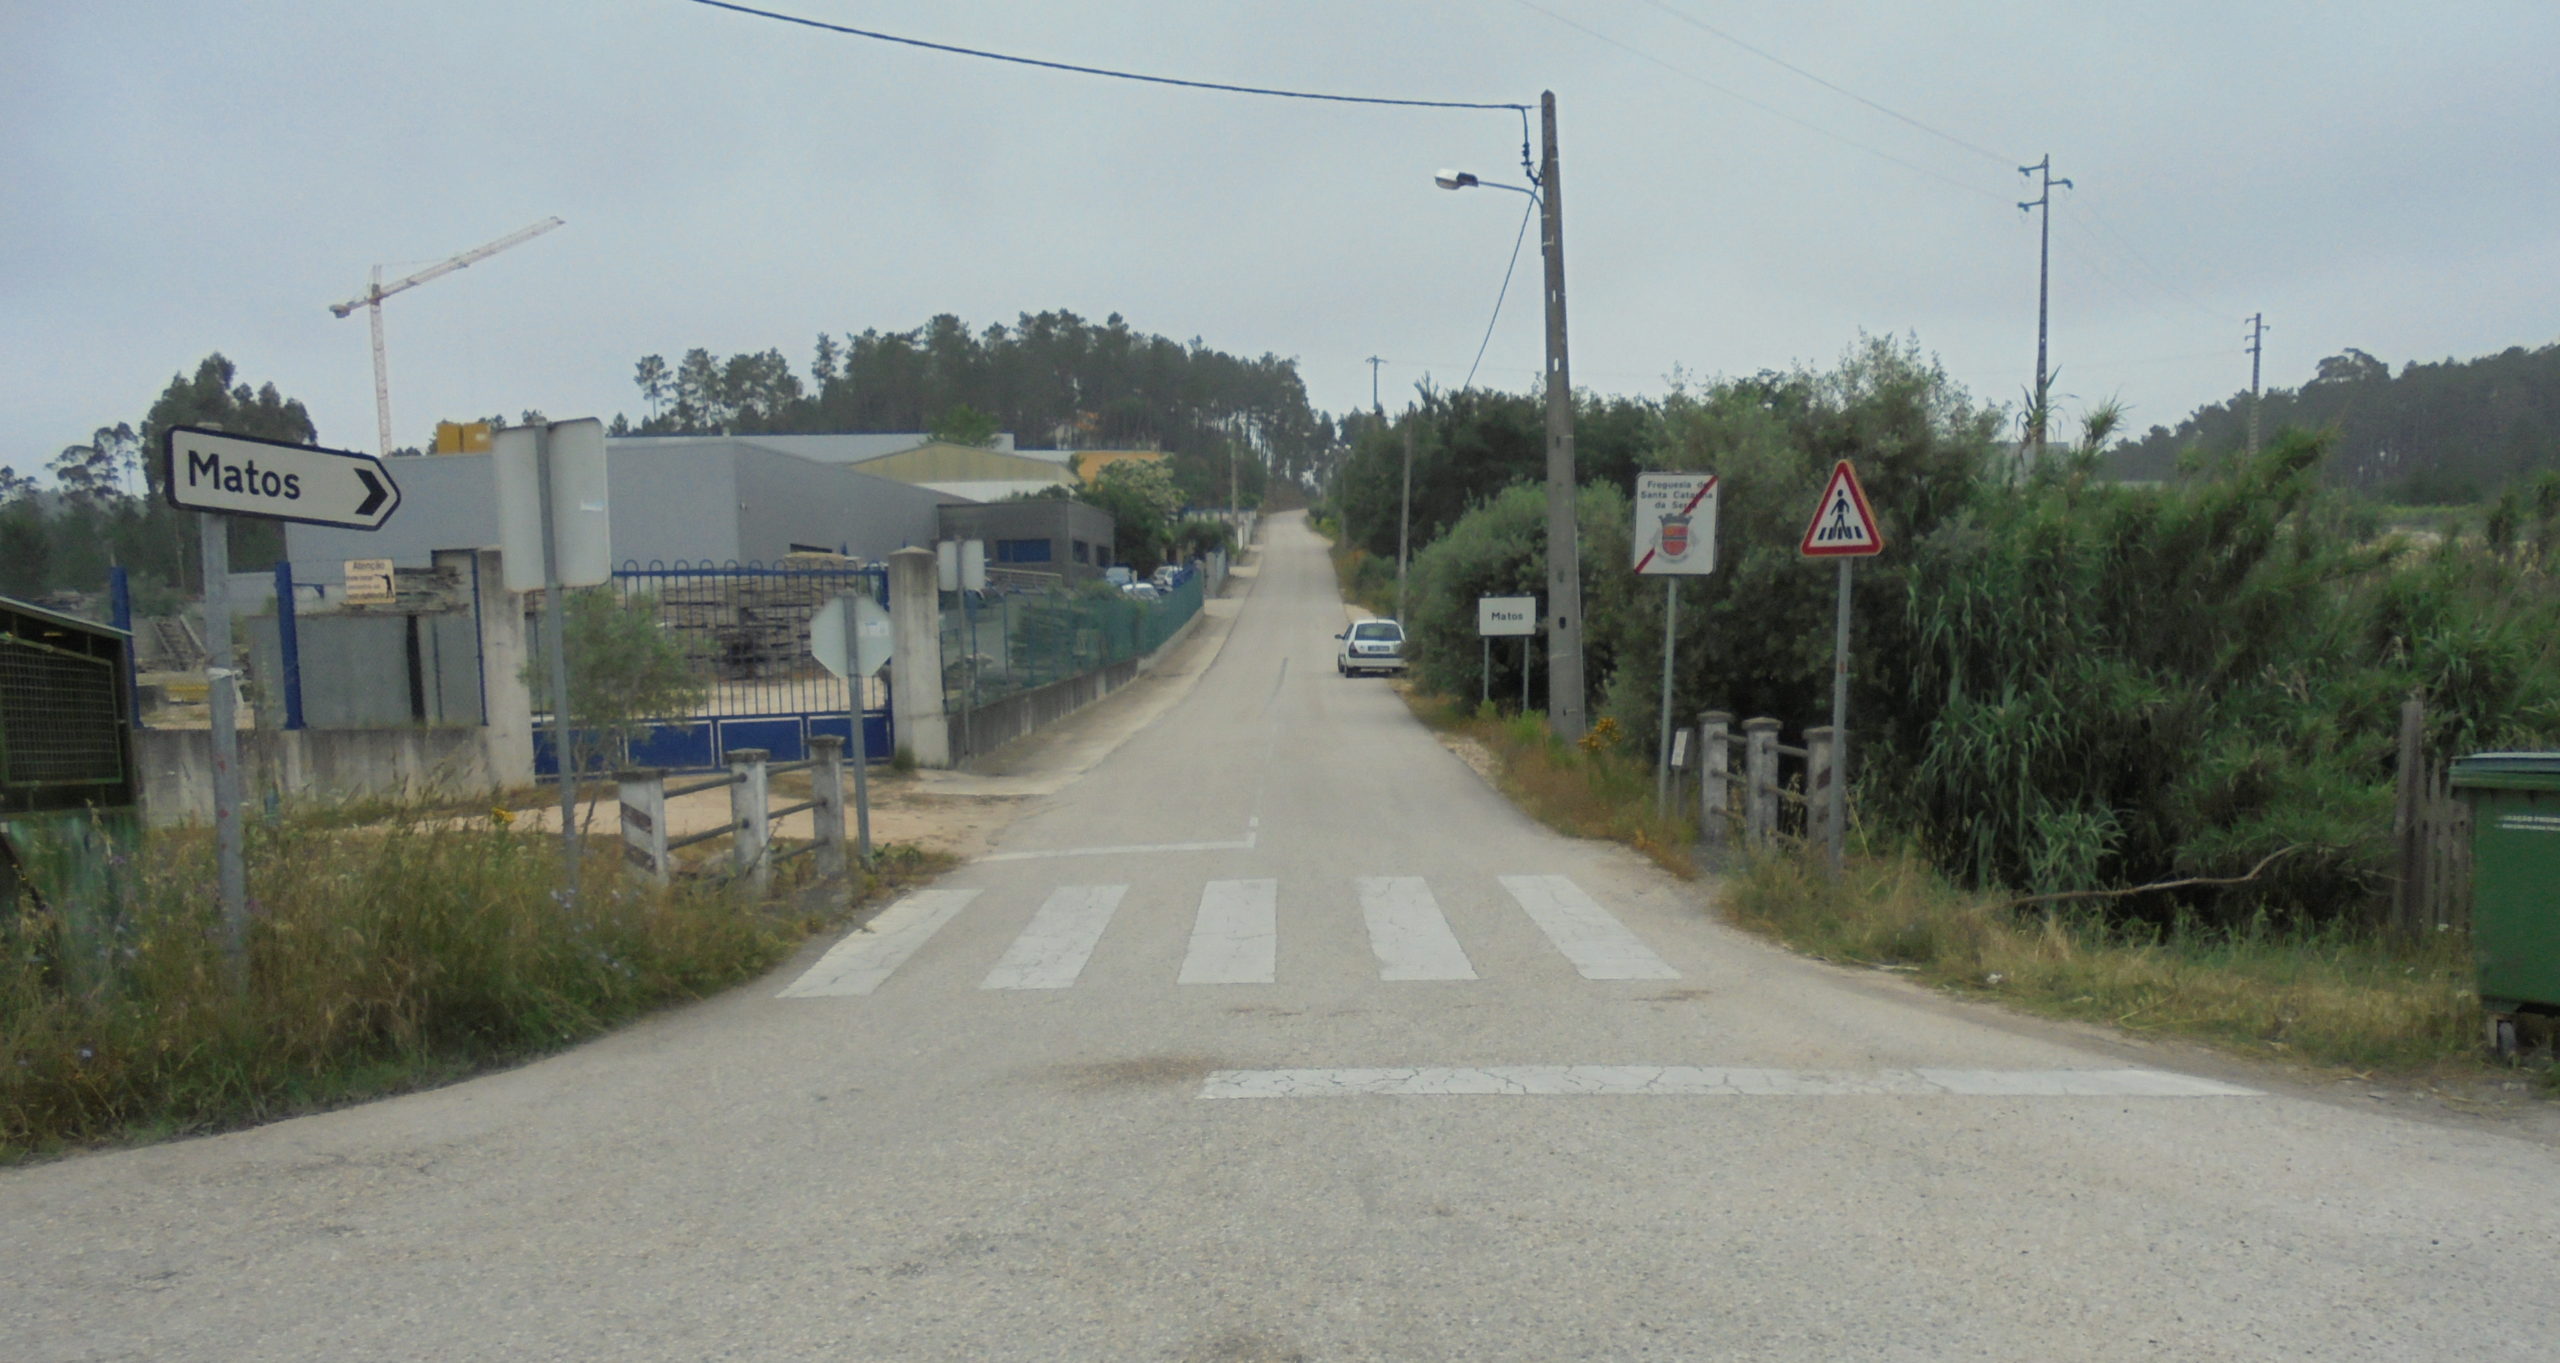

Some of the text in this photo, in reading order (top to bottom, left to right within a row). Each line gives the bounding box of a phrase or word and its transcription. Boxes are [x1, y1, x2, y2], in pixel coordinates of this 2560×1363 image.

[188, 450, 301, 500] Matos
[1647, 481, 1692, 490] Freguesia
[1641, 491, 1713, 499] Santa Catana
[1491, 612, 1524, 621] Matos
